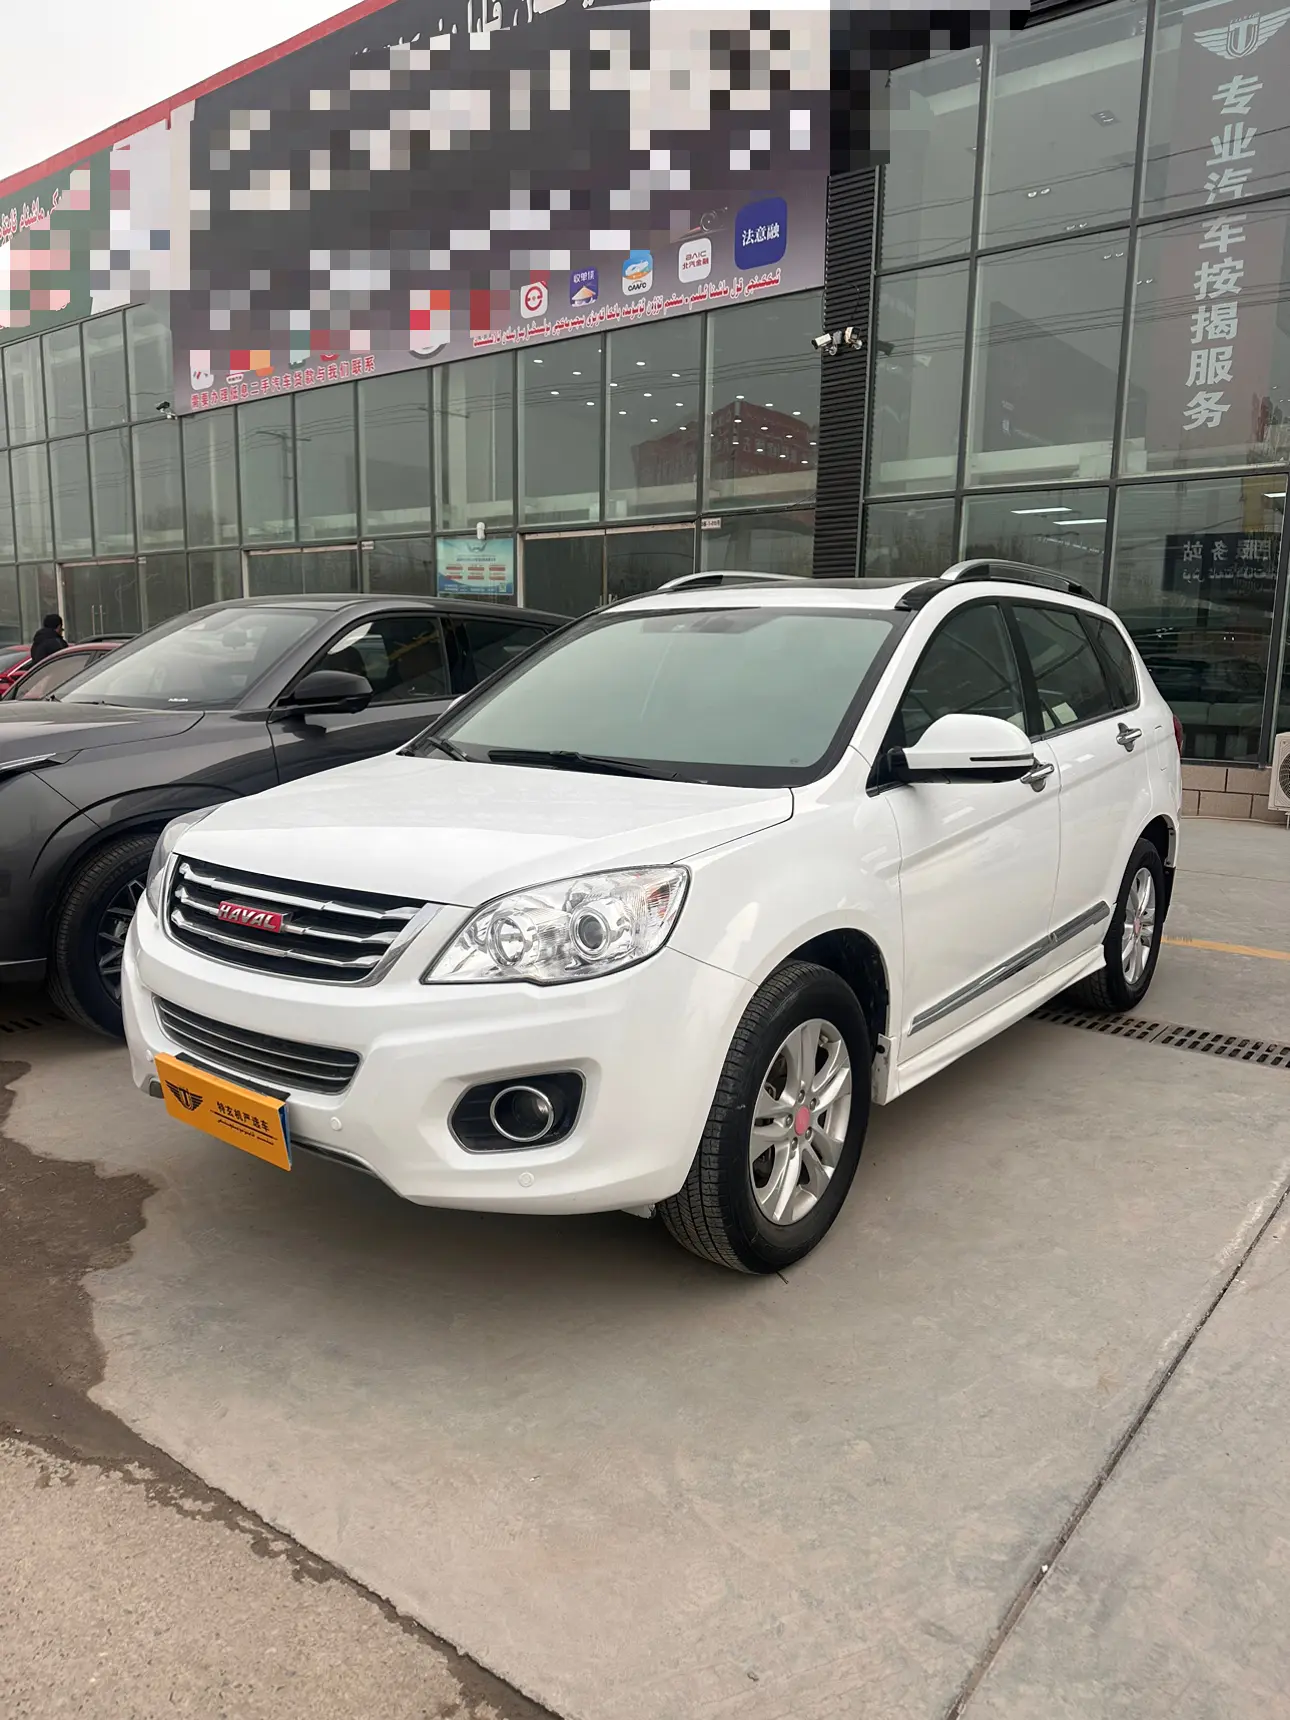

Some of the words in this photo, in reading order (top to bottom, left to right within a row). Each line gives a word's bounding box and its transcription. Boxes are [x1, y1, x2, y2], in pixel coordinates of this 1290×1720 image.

[685, 250, 707, 261] BAIC
[1183, 74, 1263, 431] 专业汽车按揭服务
[682, 257, 709, 270] 北汽金融
[217, 904, 277, 930] HAVAL
